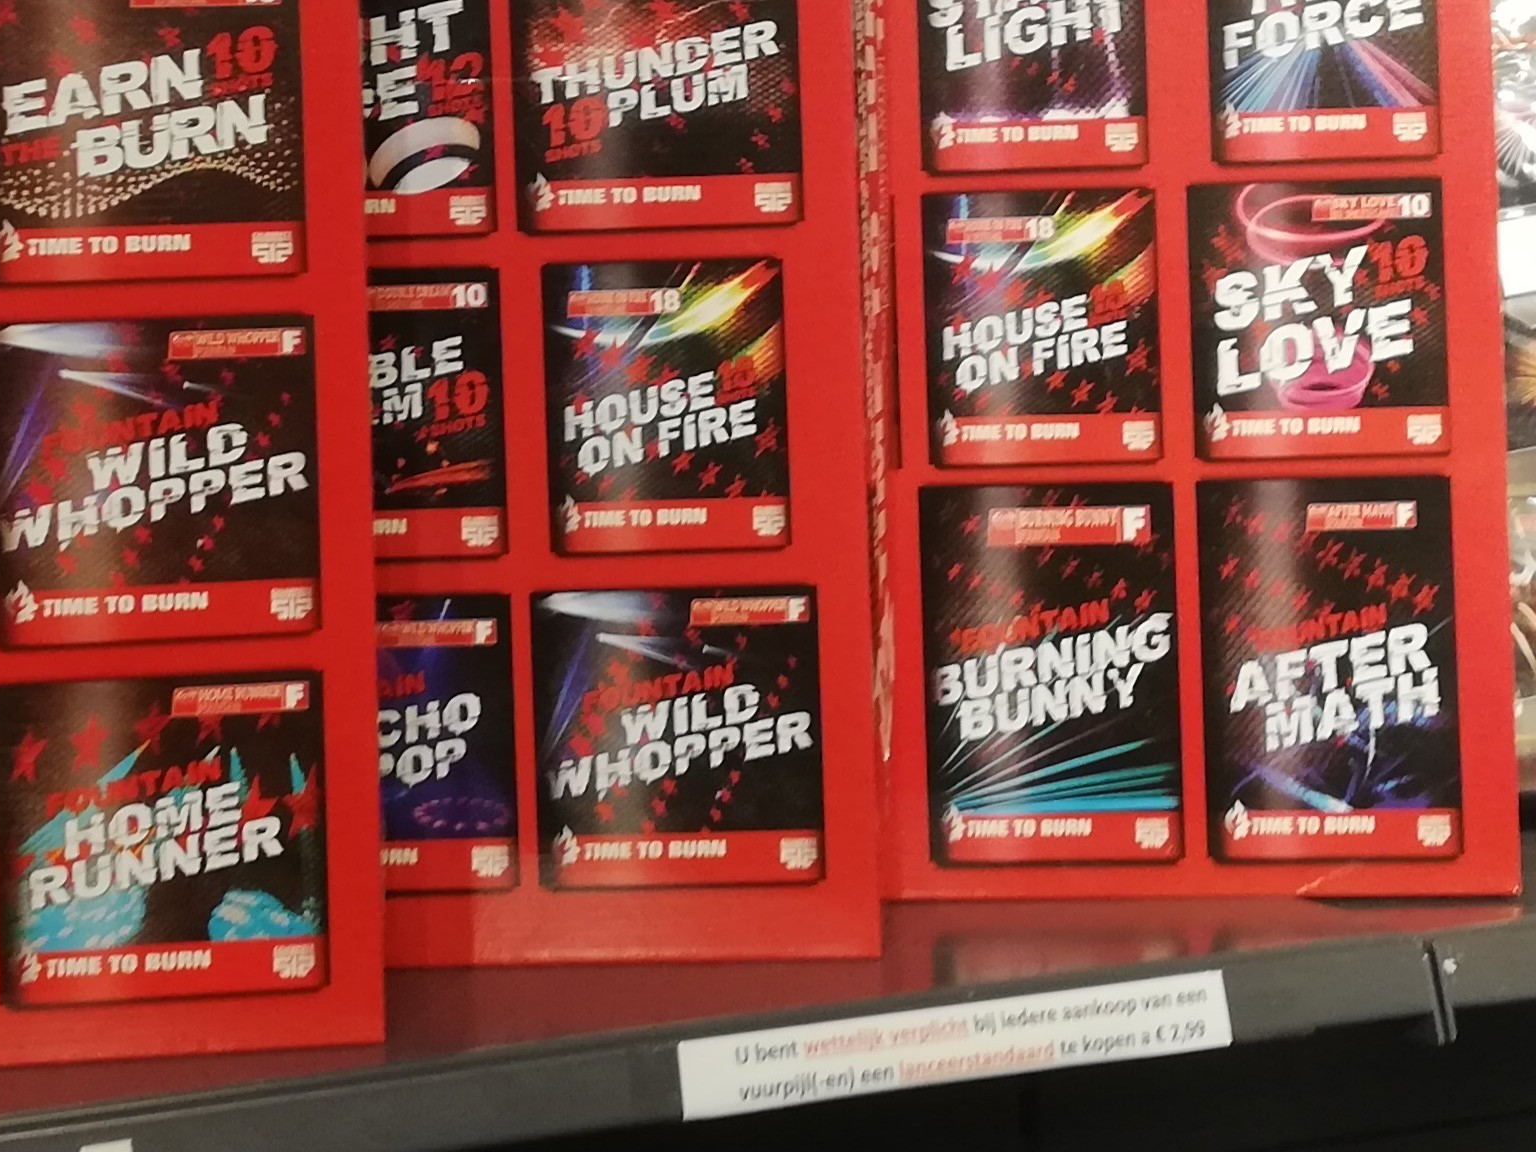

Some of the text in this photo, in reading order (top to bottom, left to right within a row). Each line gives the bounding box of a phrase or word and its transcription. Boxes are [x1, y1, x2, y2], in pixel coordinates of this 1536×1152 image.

[1, 46, 204, 138] EARN
[532, 20, 780, 105] THUNDER
[606, 65, 748, 128] PLUM
[72, 94, 269, 179] BURN
[564, 370, 717, 442] HOUSE
[577, 398, 758, 477] ON FIRE
[86, 422, 249, 491] WILD
[934, 613, 1174, 706] BURNING
[1229, 622, 1431, 713] AFTER
[958, 663, 1145, 742] BUNNY
[1264, 666, 1442, 752] MATH
[63, 782, 243, 859] HOME
[26, 816, 283, 910] RUNNER
[735, 1046, 749, 1065] U
[755, 1040, 799, 1064] bent
[972, 1013, 997, 1035] bij
[1142, 993, 1172, 1010] van
[1177, 988, 1208, 1005] een
[861, 1065, 894, 1083] een
[1060, 1040, 1077, 1056] te
[1081, 1031, 1137, 1055] kopen
